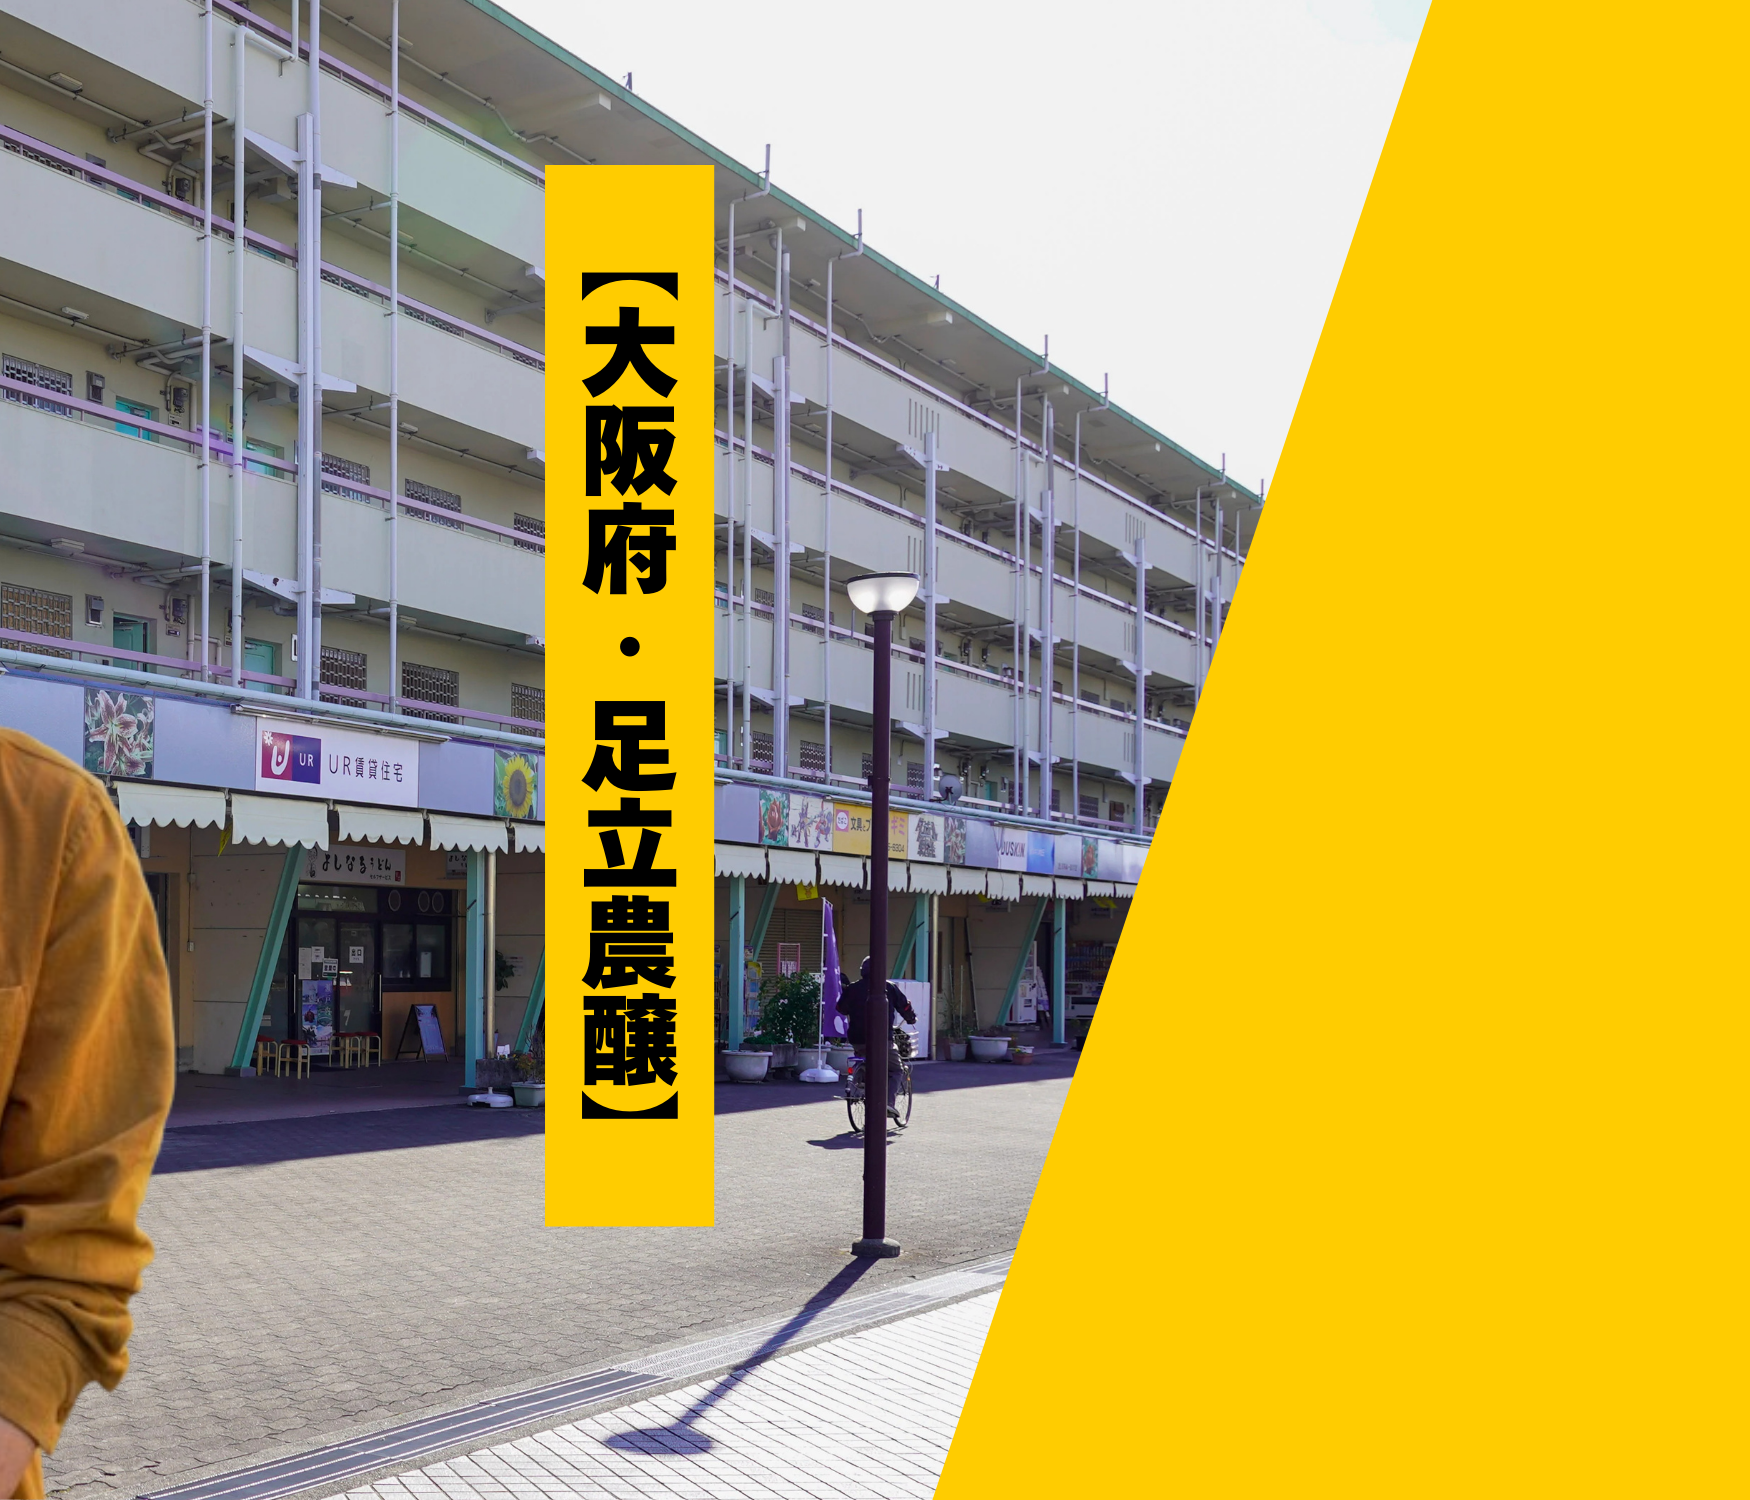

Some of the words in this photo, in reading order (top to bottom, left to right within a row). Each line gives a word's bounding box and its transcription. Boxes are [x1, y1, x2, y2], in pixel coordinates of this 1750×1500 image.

[299, 752, 314, 767] UR
[329, 753, 403, 783] UR賃貸住宅
